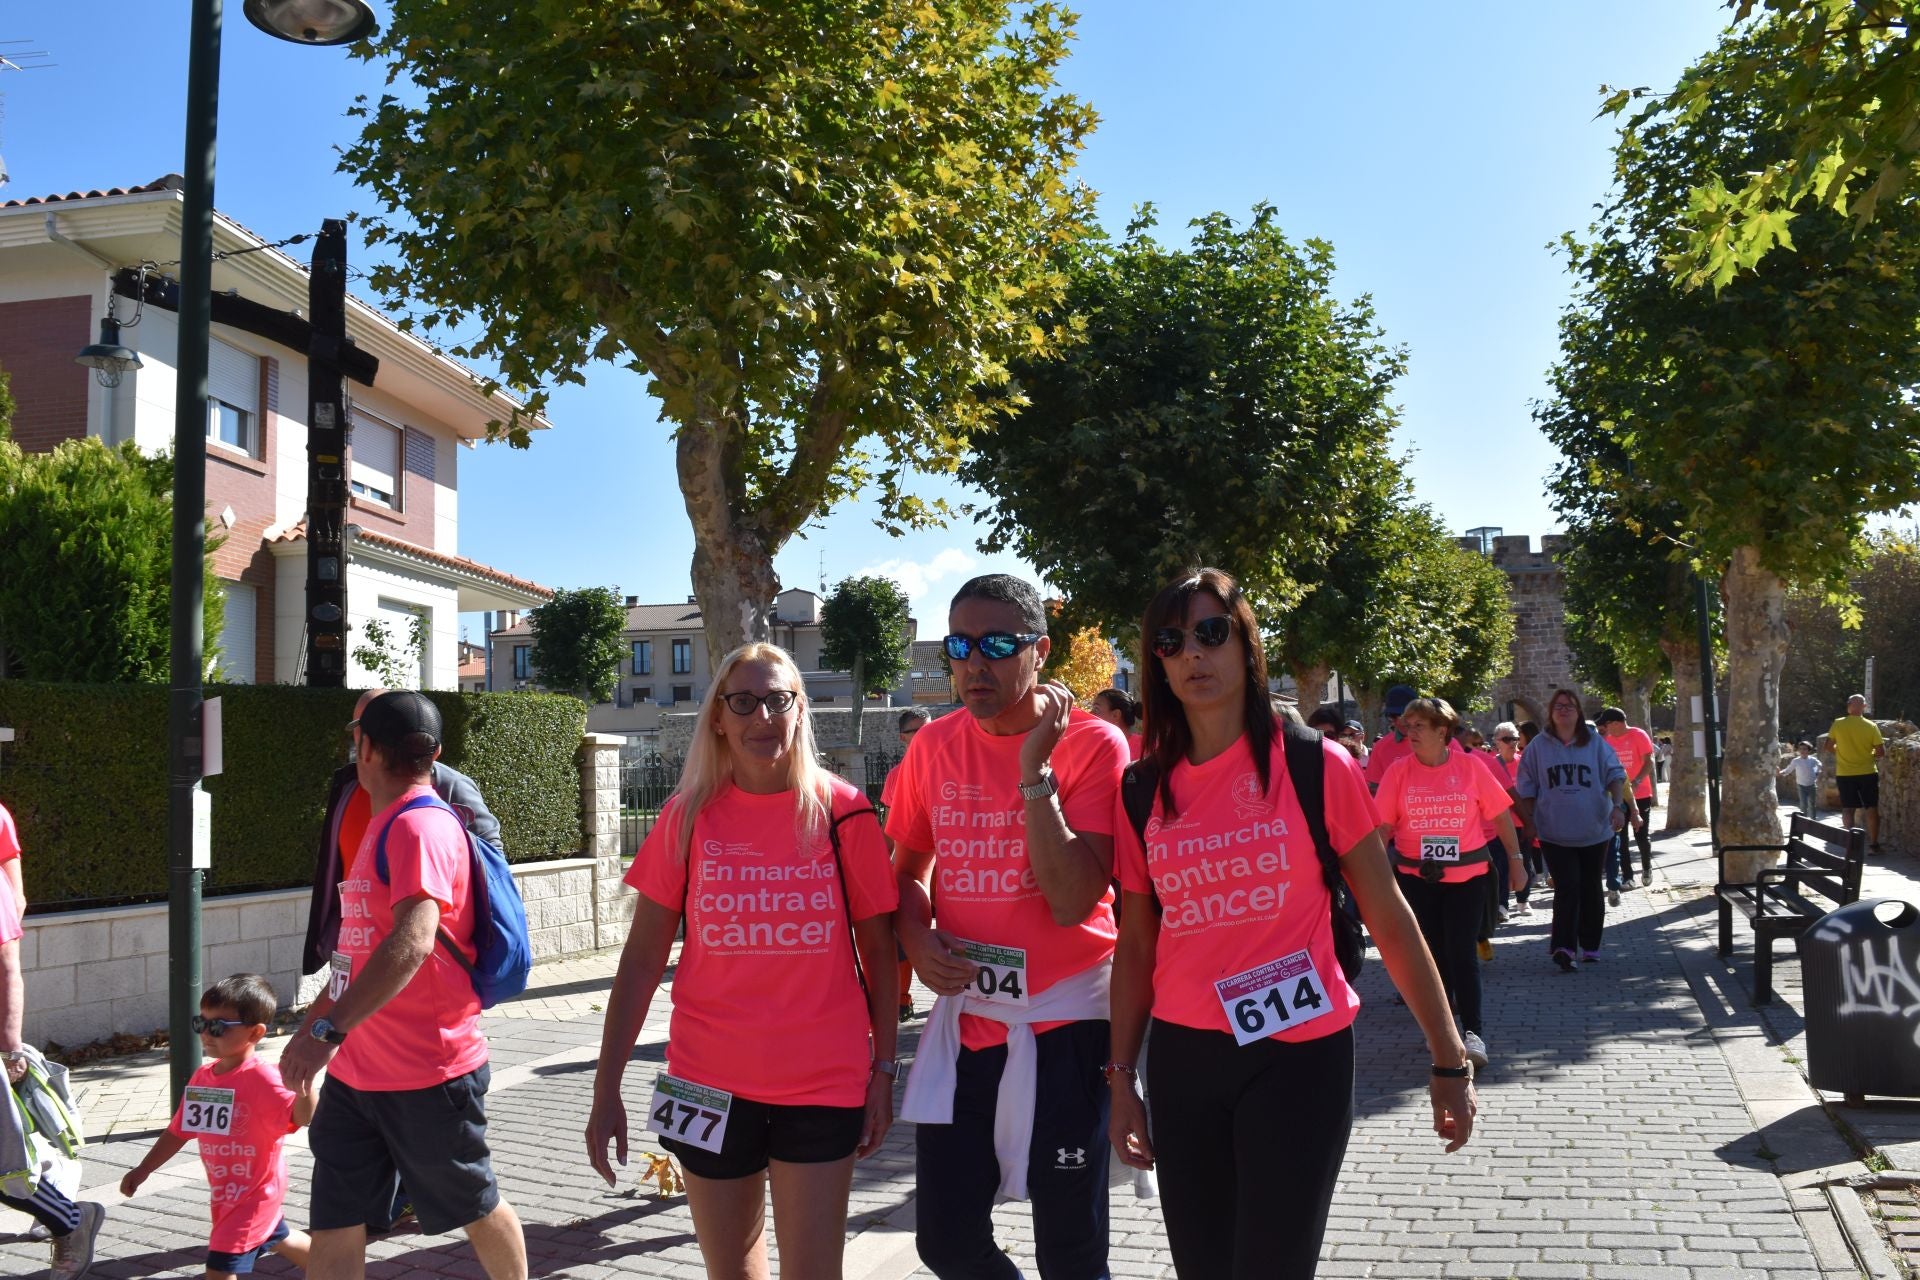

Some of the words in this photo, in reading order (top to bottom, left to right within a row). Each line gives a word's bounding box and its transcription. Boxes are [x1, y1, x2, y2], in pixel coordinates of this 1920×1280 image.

[1547, 764, 1591, 789] NYC
[1408, 795, 1421, 804] En
[1424, 792, 1467, 803] marcha
[1410, 805, 1451, 816] contra
[1454, 803, 1466, 814] el
[939, 806, 966, 827] En
[972, 808, 1026, 828] marc
[1410, 816, 1466, 829] cáncer
[937, 835, 1024, 859] contra
[1147, 841, 1168, 865] En
[1177, 818, 1289, 857] marcha
[1424, 845, 1457, 858] 204
[703, 860, 733, 881] En
[740, 859, 835, 881] marcha
[941, 861, 1038, 893] cánce
[1153, 856, 1252, 896] contra
[1256, 843, 1290, 874] el
[700, 887, 806, 913] contra
[810, 884, 836, 911] el
[1162, 880, 1291, 929] cáncer
[703, 915, 836, 947] cáncer
[964, 966, 1023, 999] 04
[1226, 971, 1252, 988] CARRERA
[1252, 963, 1275, 978] CONTRA
[1275, 961, 1284, 970] EL
[1234, 976, 1322, 1034] 614
[187, 1103, 229, 1130] 316
[653, 1099, 722, 1142] 477
[232, 1160, 252, 1179] el
[211, 1182, 248, 1201] cer
